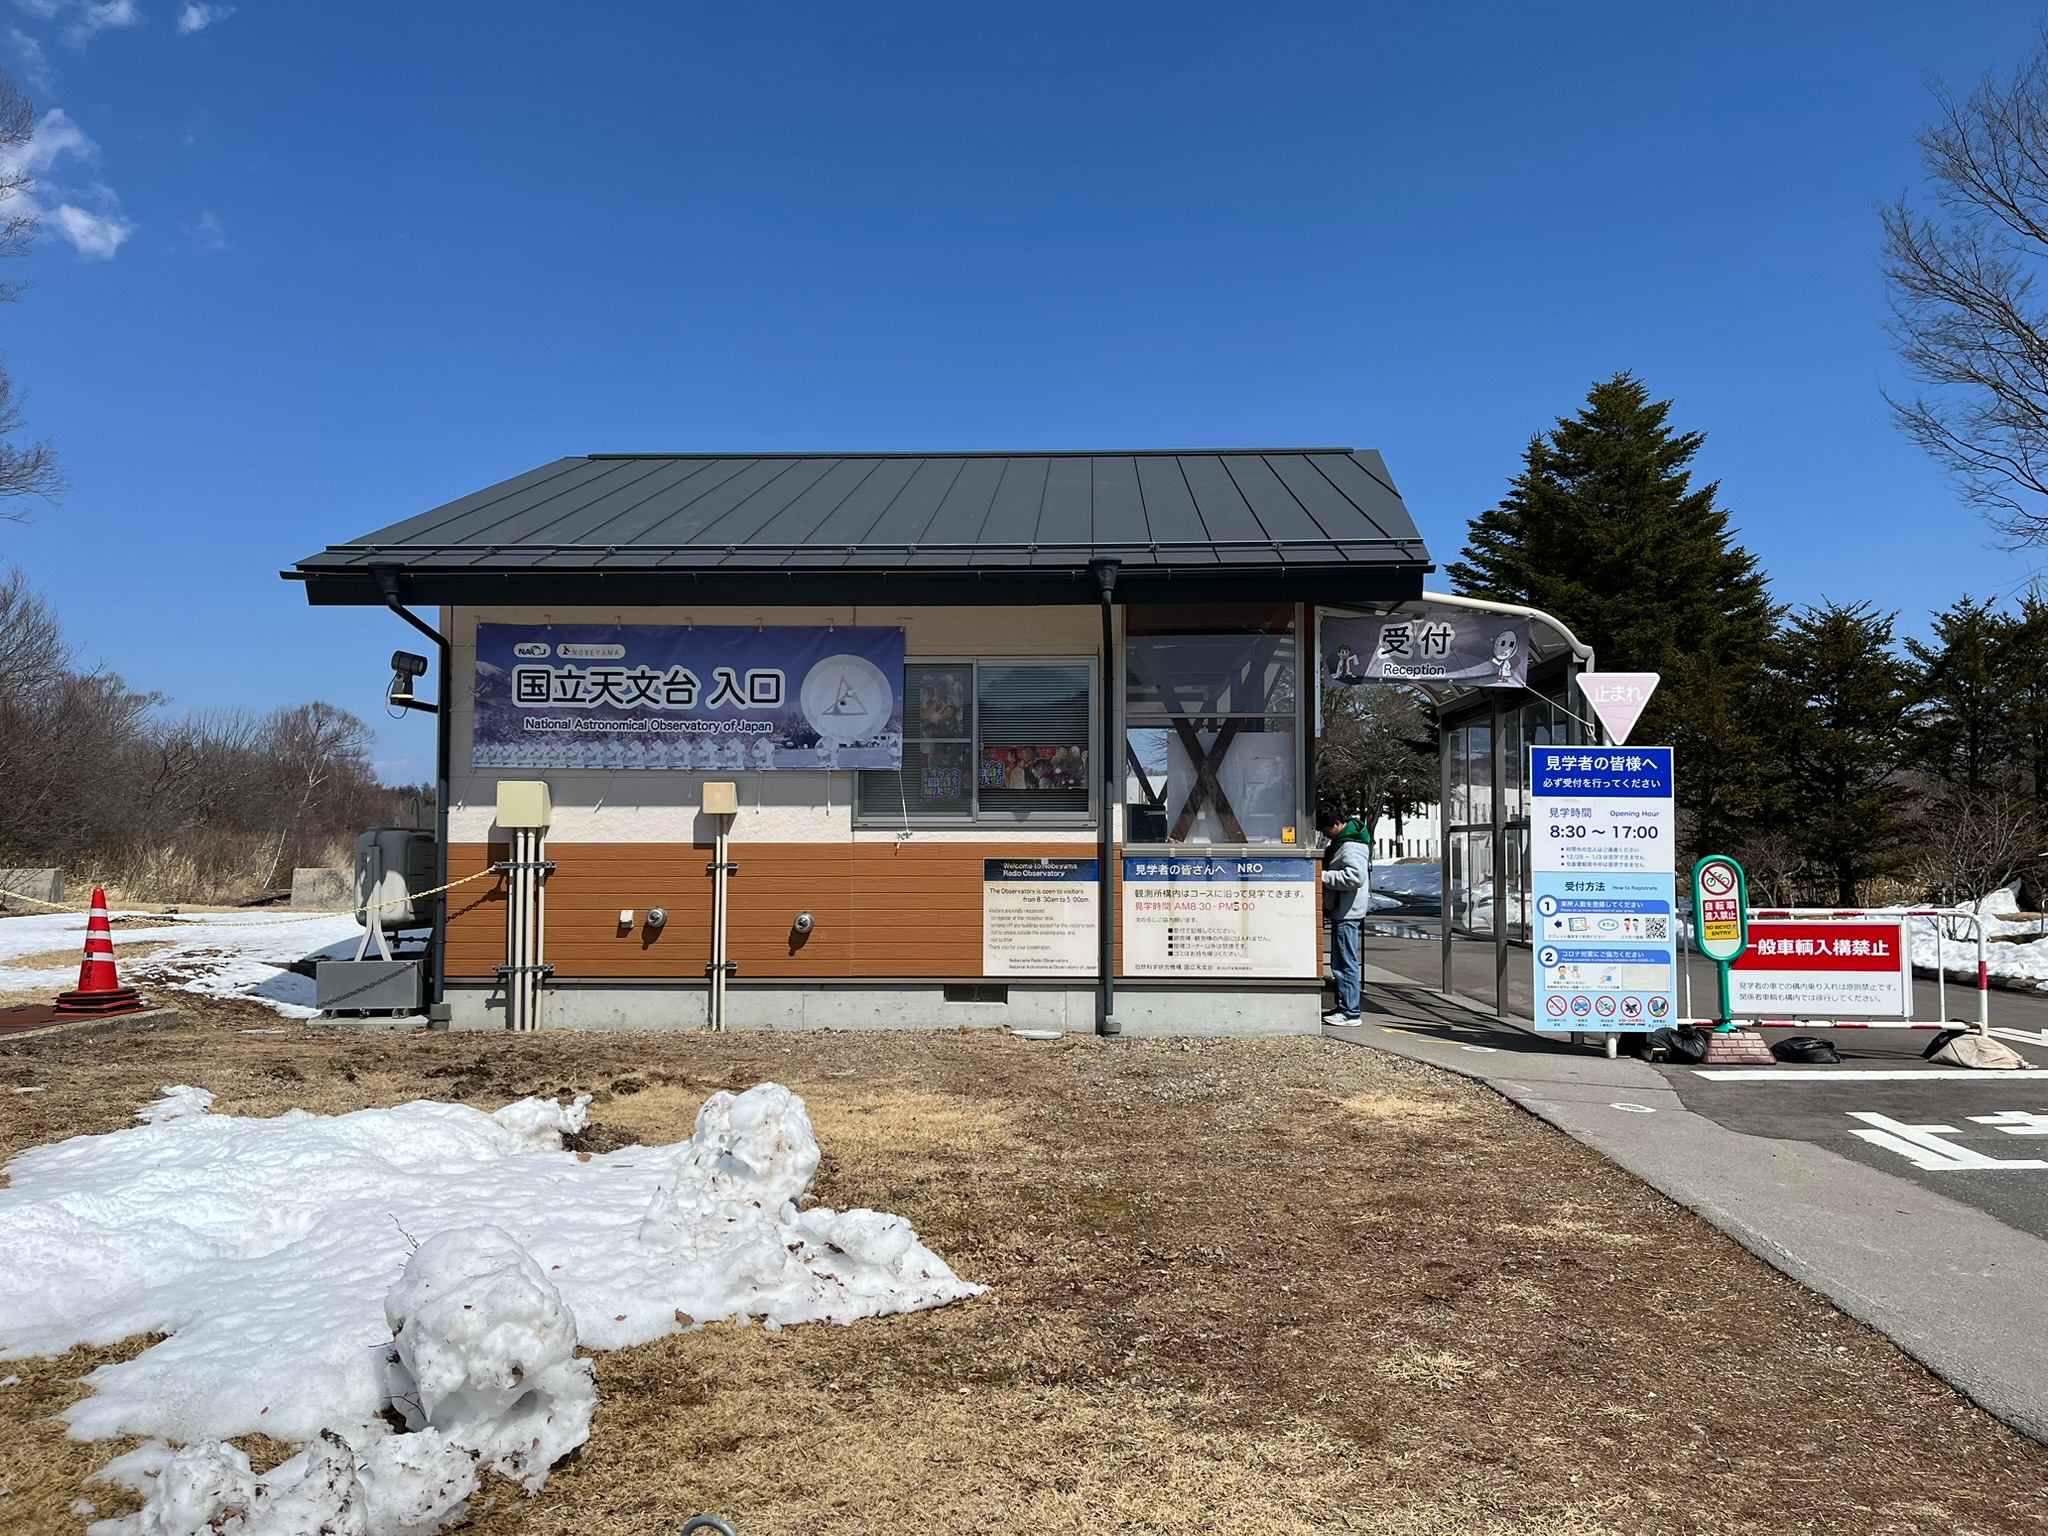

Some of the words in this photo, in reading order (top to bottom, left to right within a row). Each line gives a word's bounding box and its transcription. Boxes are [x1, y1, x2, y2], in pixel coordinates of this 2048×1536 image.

[1381, 625, 1451, 655] 受付
[572, 649, 619, 657] NOBEYAMA
[1384, 663, 1445, 677] Reception
[517, 669, 697, 704] 国立天文台
[710, 670, 781, 704] 入口
[1594, 685, 1644, 702] 止まれ
[525, 718, 571, 730] National
[574, 719, 647, 731] Astronomical
[650, 720, 719, 733] Observatory
[722, 721, 736, 732] of
[738, 722, 772, 733] Japan
[1546, 755, 1658, 772] 見学者の皆様へ
[1543, 778, 1661, 788] 必ず受付を行ってください
[1549, 807, 1592, 818] 見学時間
[1610, 810, 1640, 818] Opening
[1642, 810, 1660, 818] Hour
[1550, 825, 1586, 838] 8:30
[1613, 826, 1658, 839] 17:00
[1135, 864, 1227, 876] 見学者の皆さんへ
[1237, 864, 1264, 873] NRO
[1565, 881, 1605, 892] 受付方法
[1134, 889, 1304, 899] 観測所構内はコースに沿って見学できます。
[1135, 902, 1171, 911] 見学時間
[1545, 902, 1550, 911] 1
[1704, 901, 1736, 910] 自転車
[1704, 911, 1736, 920] 進入禁止
[1545, 952, 1553, 961] 2
